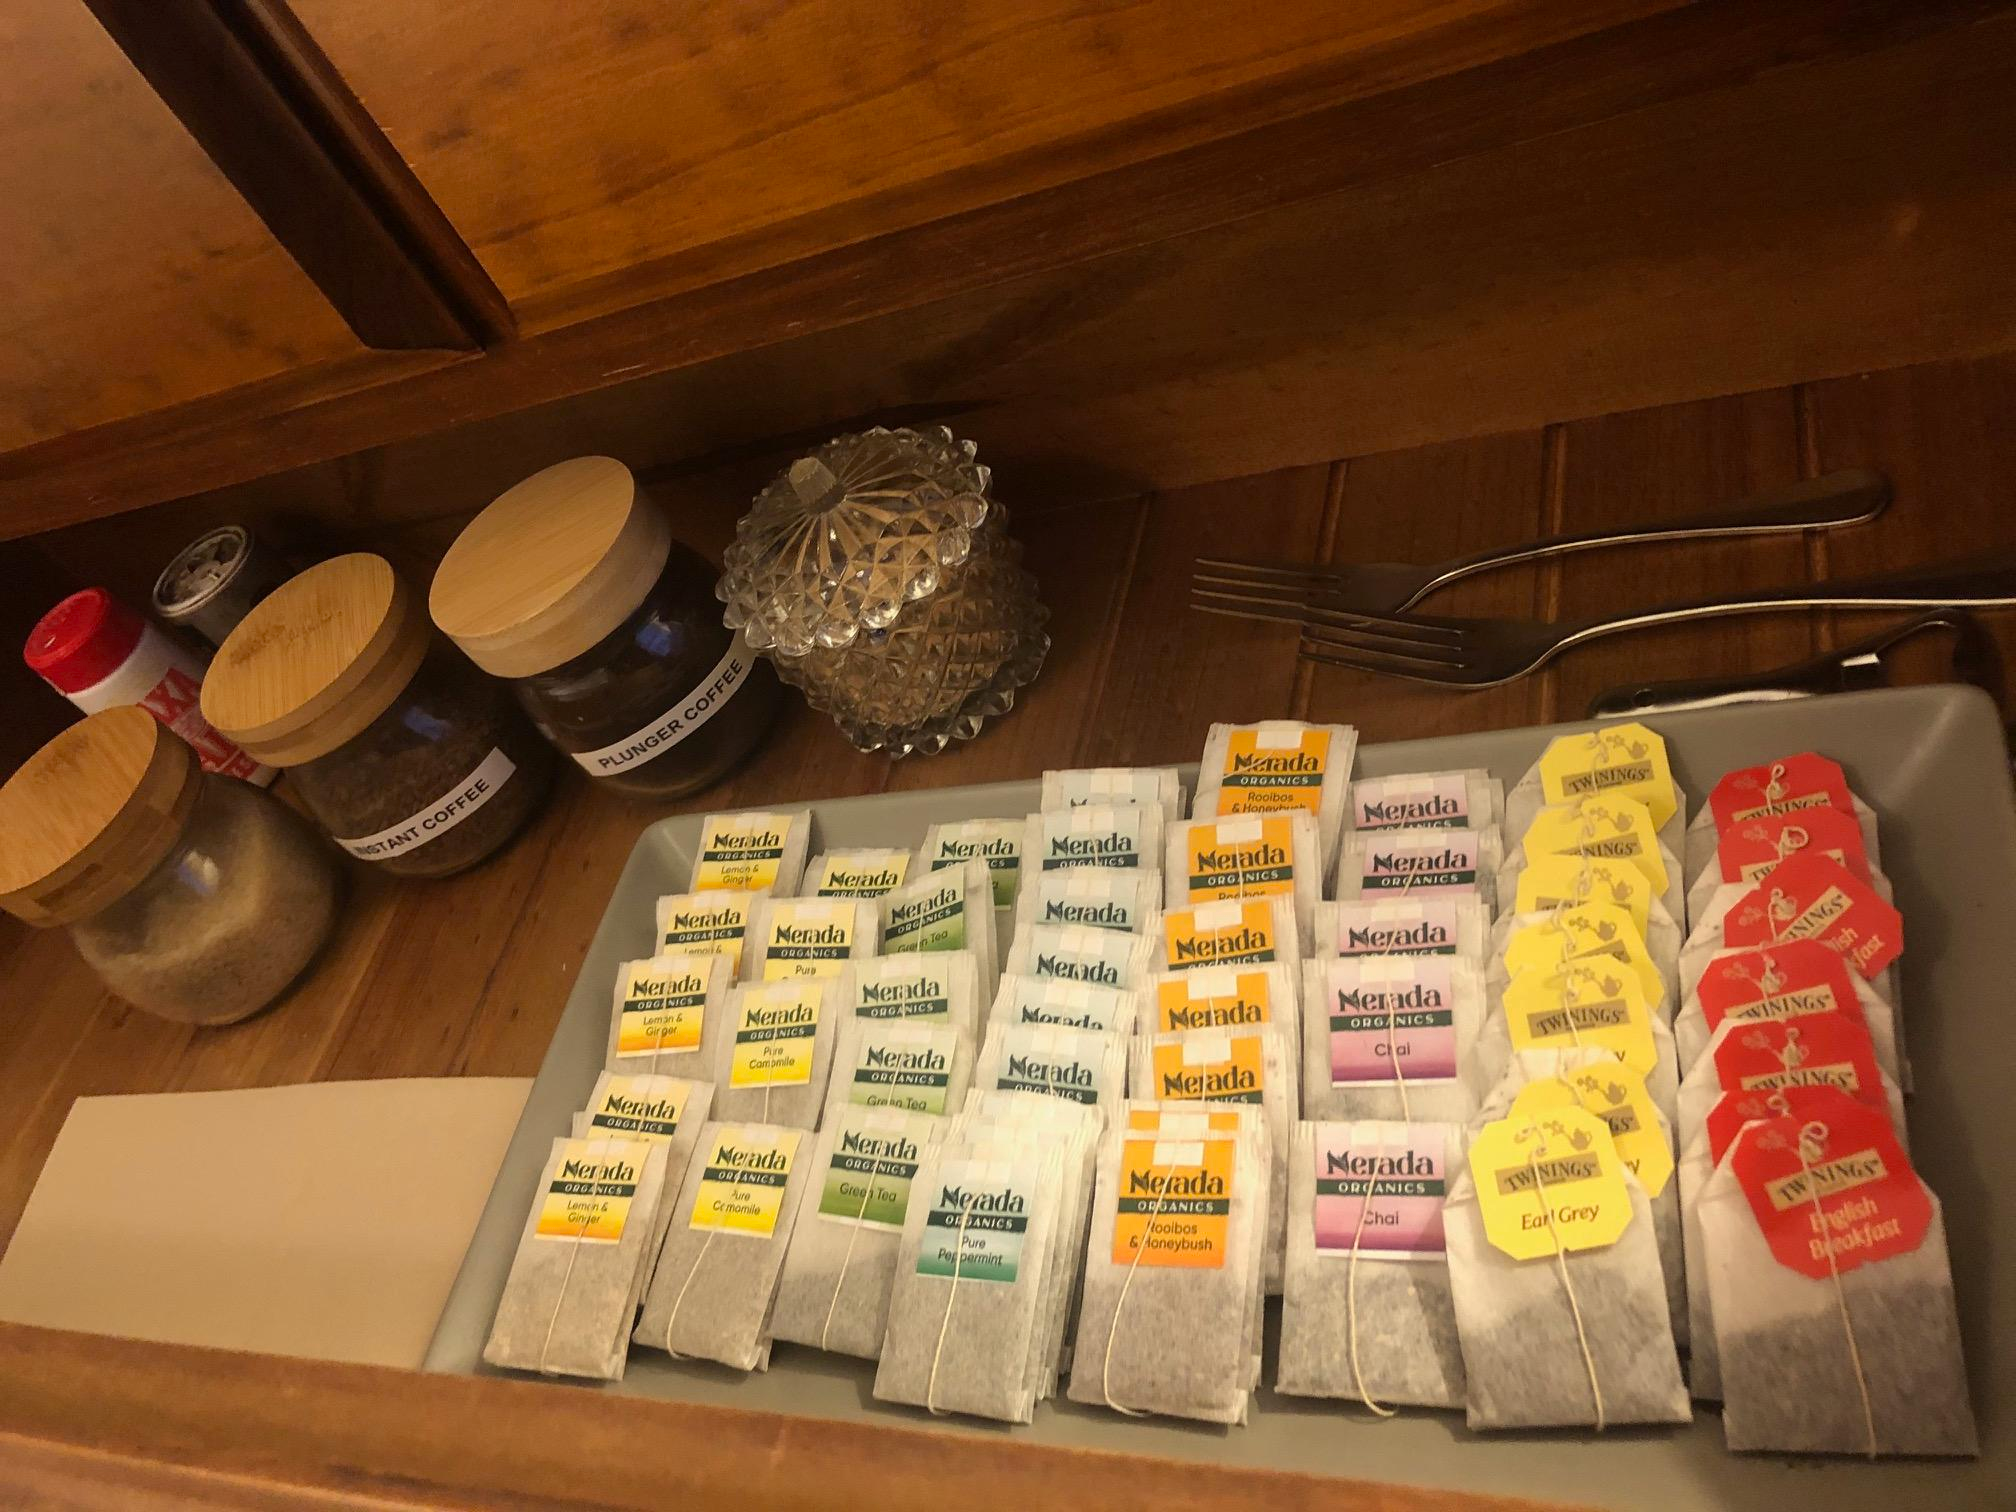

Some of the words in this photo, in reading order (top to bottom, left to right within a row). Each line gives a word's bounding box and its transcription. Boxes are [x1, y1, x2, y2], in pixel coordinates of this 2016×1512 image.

[597, 719, 685, 770] PLUNGER
[684, 658, 743, 723] COFFEE
[1233, 752, 1319, 773] Nerada
[1240, 776, 1310, 786] ORGANICS
[1568, 768, 1646, 793] TWININGS
[422, 778, 490, 830] COFFEE
[1247, 791, 1294, 802] Rooibos
[1232, 803, 1240, 813] &
[1362, 794, 1459, 823] Nerada
[713, 831, 780, 850] Nerada
[940, 836, 1014, 858] Nerada
[1051, 832, 1132, 856] Nerada
[716, 851, 771, 860] ORGANICS
[1197, 843, 1286, 873] Nerada
[1372, 849, 1468, 873] Nerada
[720, 865, 750, 874] Lemon
[752, 864, 760, 873] &
[828, 869, 898, 888] Nerada
[1207, 871, 1279, 886] ORGANICS
[1381, 874, 1459, 887] ORGANICS
[890, 886, 957, 925] Nerada
[1045, 899, 1127, 924] Nerada
[673, 908, 741, 930] Nerada
[897, 908, 952, 935] ORGANICS
[678, 930, 733, 942] ORGANICS
[775, 923, 846, 945] Nerada
[930, 929, 949, 946] Tea
[1175, 927, 1267, 961] Nerada
[1347, 921, 1447, 949] Nerada
[780, 949, 838, 959] ORGANICS
[795, 965, 817, 976] Pure
[1036, 953, 1118, 985] Nerada
[632, 974, 702, 999] Nerada
[862, 977, 940, 1004] Nerada
[637, 997, 694, 1010] ORGANICS
[1337, 984, 1442, 1012] Nerada
[643, 1015, 675, 1026] Lemon
[676, 1013, 683, 1023] &
[745, 1003, 814, 1028] Nerada
[870, 1002, 935, 1018] ORGANICS
[1168, 1000, 1262, 1031] Nerada
[1350, 1014, 1435, 1028] ORGANICS
[1536, 1007, 1621, 1036] TWININGS
[750, 1028, 805, 1041] ORGANICS
[865, 1045, 945, 1070] Nerada
[1374, 1042, 1412, 1057] Chai
[748, 1057, 796, 1071] Camomile
[1007, 1054, 1093, 1087] Nerada
[870, 1072, 935, 1085] ORGANICS
[1163, 1065, 1256, 1096] Nerada
[604, 1094, 676, 1120] Nerada
[905, 1098, 928, 1111] Tea
[606, 1117, 664, 1133] ORGANICS
[841, 1128, 918, 1161] Nerada
[714, 1144, 787, 1171] Nerada
[845, 1157, 907, 1176] ORGANICS
[1326, 1149, 1434, 1176] Nerada
[561, 1158, 635, 1182] Nerada
[718, 1170, 776, 1185] ORGANICS
[1503, 1160, 1592, 1192] TWININGS
[1778, 1159, 1876, 1202] TWNINGS
[564, 1183, 623, 1195] ORGANICS
[839, 1182, 874, 1199] Green
[877, 1189, 897, 1203] Tea
[1129, 1168, 1224, 1195] Nerada
[1338, 1182, 1426, 1194] ORGANICS
[567, 1200, 599, 1212] Lemon
[600, 1202, 608, 1212] &
[939, 1184, 1025, 1214] Nerada
[1137, 1200, 1215, 1213] ORGANICS
[1364, 1210, 1400, 1226] Chai
[1521, 1209, 1555, 1231] Earl
[1558, 1204, 1600, 1224] Grey
[1808, 1196, 1879, 1234] English
[1146, 1221, 1198, 1235] Rooibos
[961, 1235, 986, 1249] Pure
[1129, 1236, 1139, 1248] &
[1808, 1218, 1902, 1262] Breakfast
[937, 1249, 1004, 1268] Peppermint
